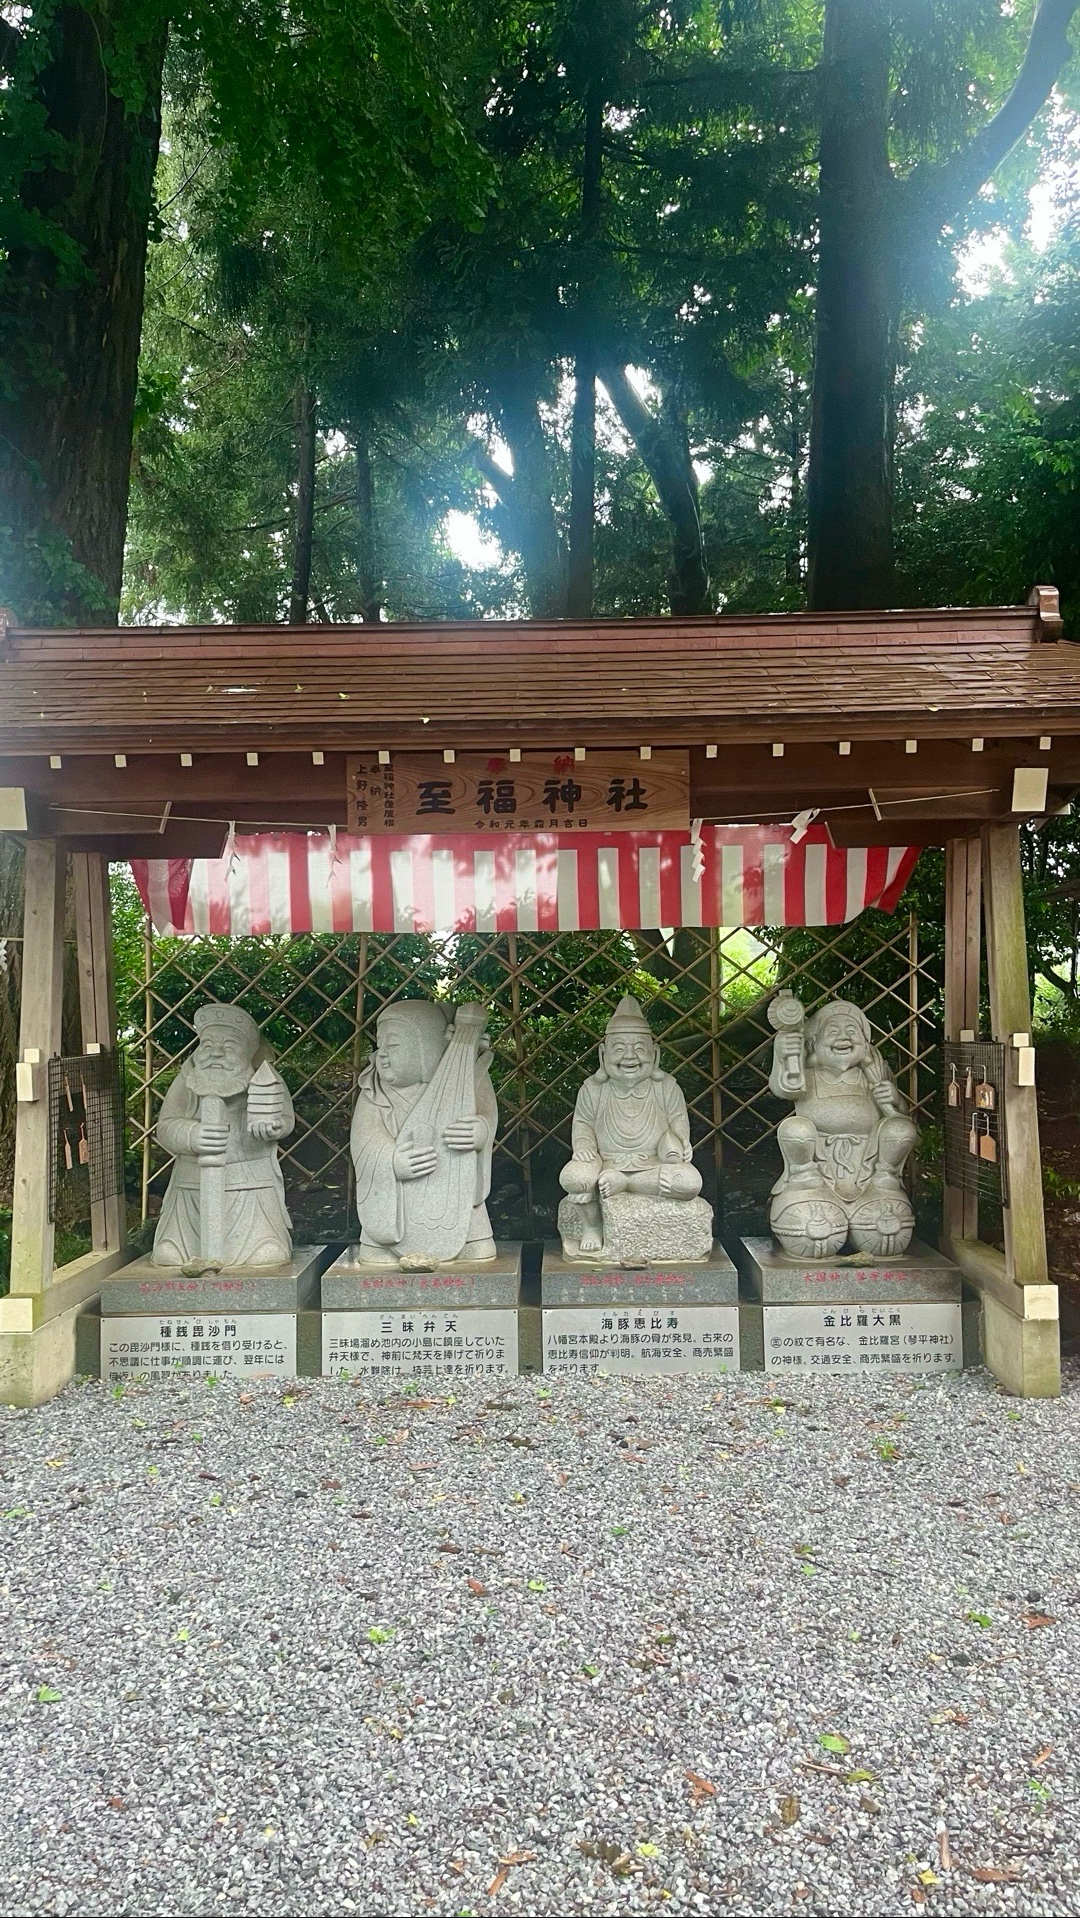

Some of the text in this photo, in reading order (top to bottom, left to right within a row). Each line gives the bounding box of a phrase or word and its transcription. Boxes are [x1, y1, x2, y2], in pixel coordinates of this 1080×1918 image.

[356, 764, 369, 827] 上野隆男
[415, 777, 649, 815] 至福神社
[474, 818, 588, 829] 令和元年霜月吉日
[381, 1320, 458, 1333] 三昧弁天
[601, 1317, 679, 1330] 海豚恵比寿
[823, 1314, 902, 1327] 金比羅大黒
[160, 1325, 237, 1338] 種銭毘沙門
[328, 1336, 506, 1349] 三昧場溜め池内の小島に鎮座していた
[547, 1332, 734, 1345] 八幡宮本殿より海豚の骨が発見。古来の
[108, 1340, 289, 1353] この毘沙門様に、種銭を借り受けると、
[328, 1348, 506, 1362] 弁天様で、神前に梵天を捧げて祈りま
[547, 1347, 735, 1360] 恵比寿信仰が判明。航海安全、商売繁盛
[771, 1352, 957, 1366] の神様。交通安全、商売繁盛を祈ります。
[108, 1354, 285, 1367] 不思議に仕事が順調に運び、翌年には
